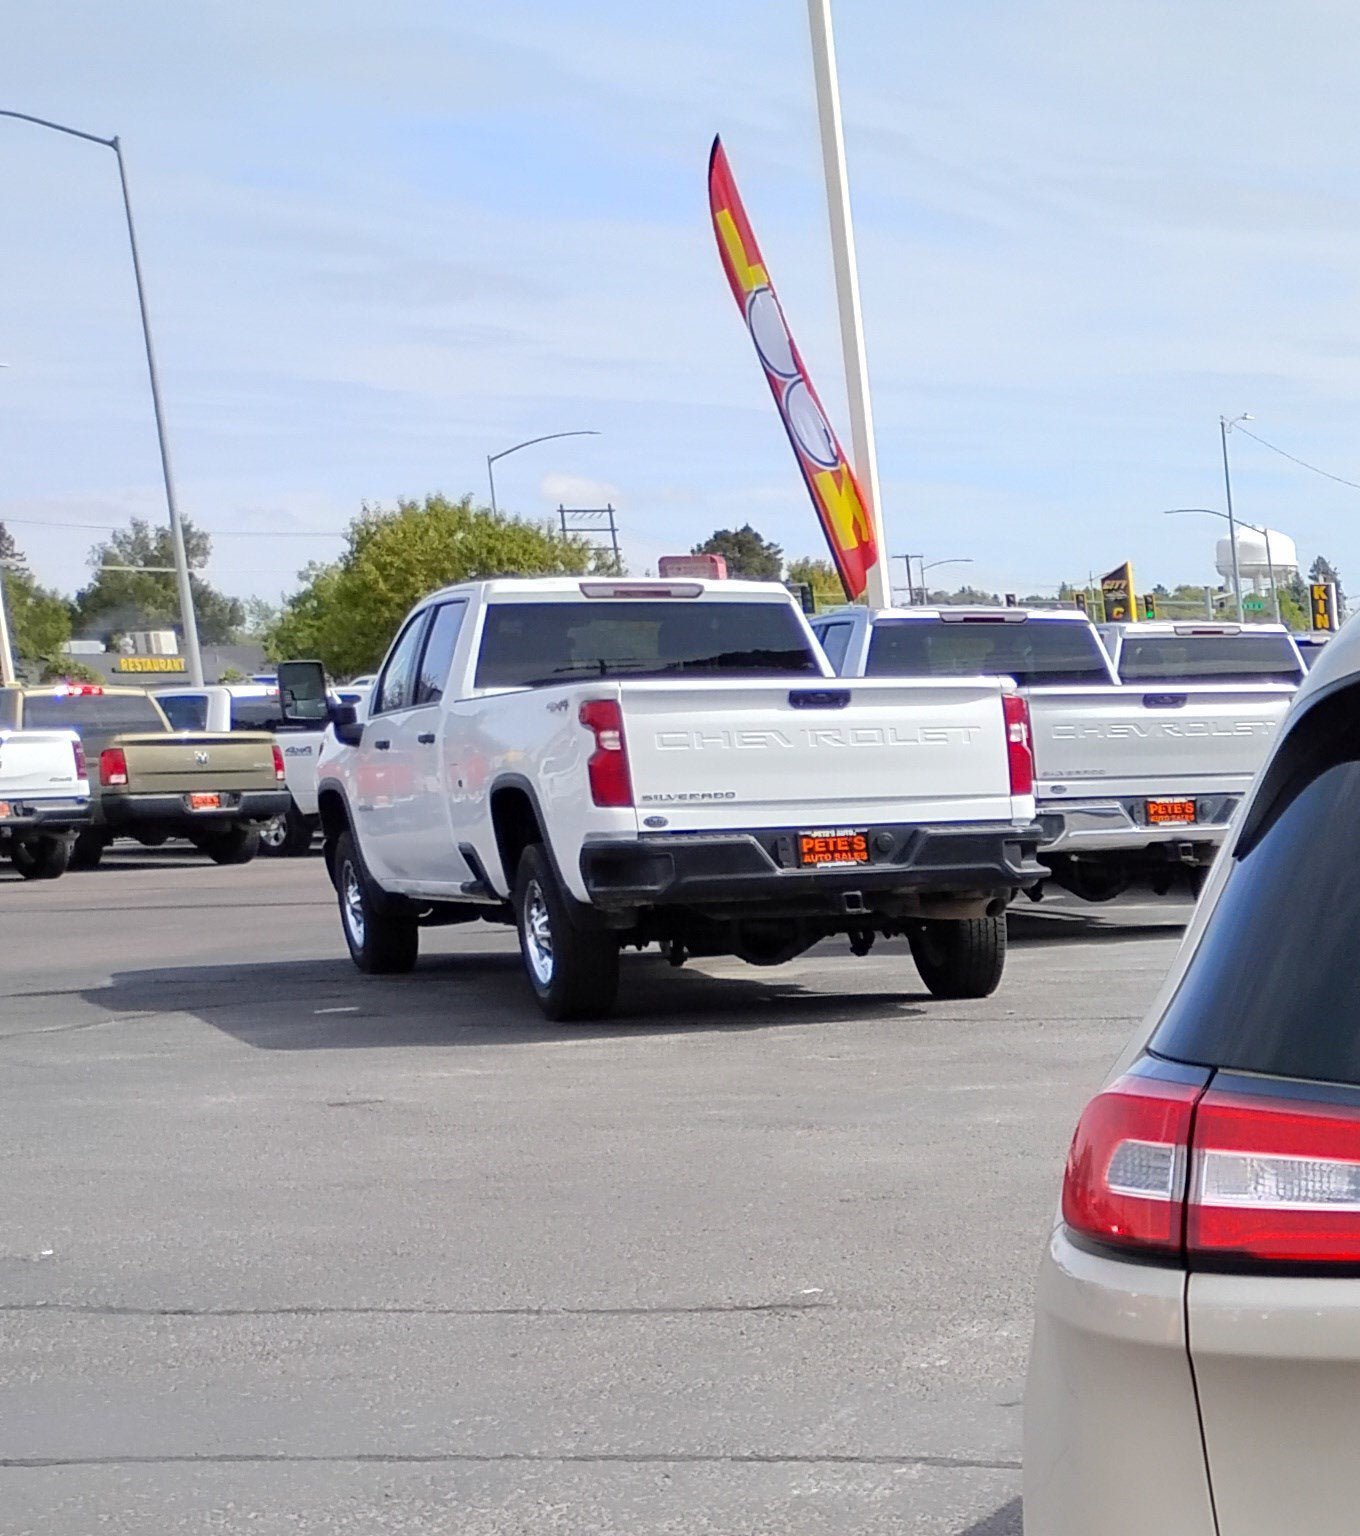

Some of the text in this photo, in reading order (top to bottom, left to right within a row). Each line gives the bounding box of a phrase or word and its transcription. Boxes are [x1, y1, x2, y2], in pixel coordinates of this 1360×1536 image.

[120, 657, 186, 672] RESTAURANT
[654, 725, 982, 751] CHEVROLET
[1051, 721, 1277, 740] CHEVROLET
[641, 791, 736, 801] SILVERADO
[1149, 802, 1195, 814] PETE'S
[802, 835, 867, 852] PETE'S
[803, 850, 868, 863] AUTO SALES
